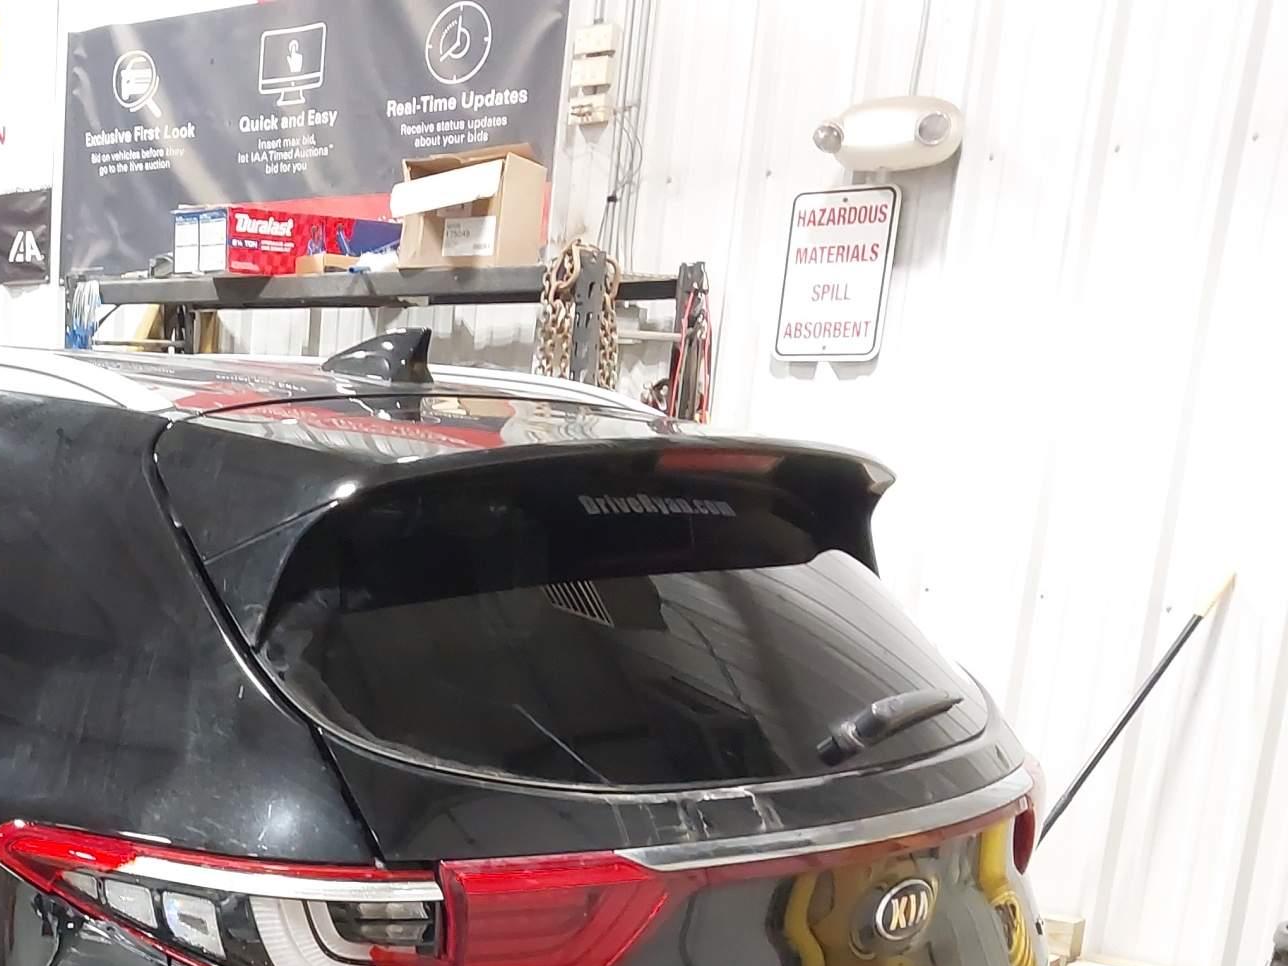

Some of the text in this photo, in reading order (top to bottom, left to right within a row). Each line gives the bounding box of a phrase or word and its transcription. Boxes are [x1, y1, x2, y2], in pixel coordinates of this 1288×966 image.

[386, 89, 528, 118] Real-Time Updates
[239, 109, 337, 132] Quick and Easy
[401, 116, 508, 136] Receive status updates
[85, 121, 196, 147] Exclusive First Look
[258, 138, 281, 150] Insert
[282, 138, 300, 147] max
[414, 130, 488, 148] about your bids
[111, 149, 141, 162] vehicles
[141, 147, 164, 159] before
[250, 151, 268, 163] IAA
[268, 149, 293, 161] Timed
[99, 166, 108, 176] go
[109, 165, 116, 174] to
[117, 162, 129, 174] the
[145, 158, 171, 171] auction
[265, 161, 307, 175] bid for you
[235, 212, 294, 237] Duralast
[797, 203, 888, 228] HAZARDOUS
[795, 242, 880, 266] MATERIALS
[811, 282, 852, 302] SPILL
[783, 320, 872, 339] ABSORBENT
[578, 494, 737, 517] DriveRyan.com
